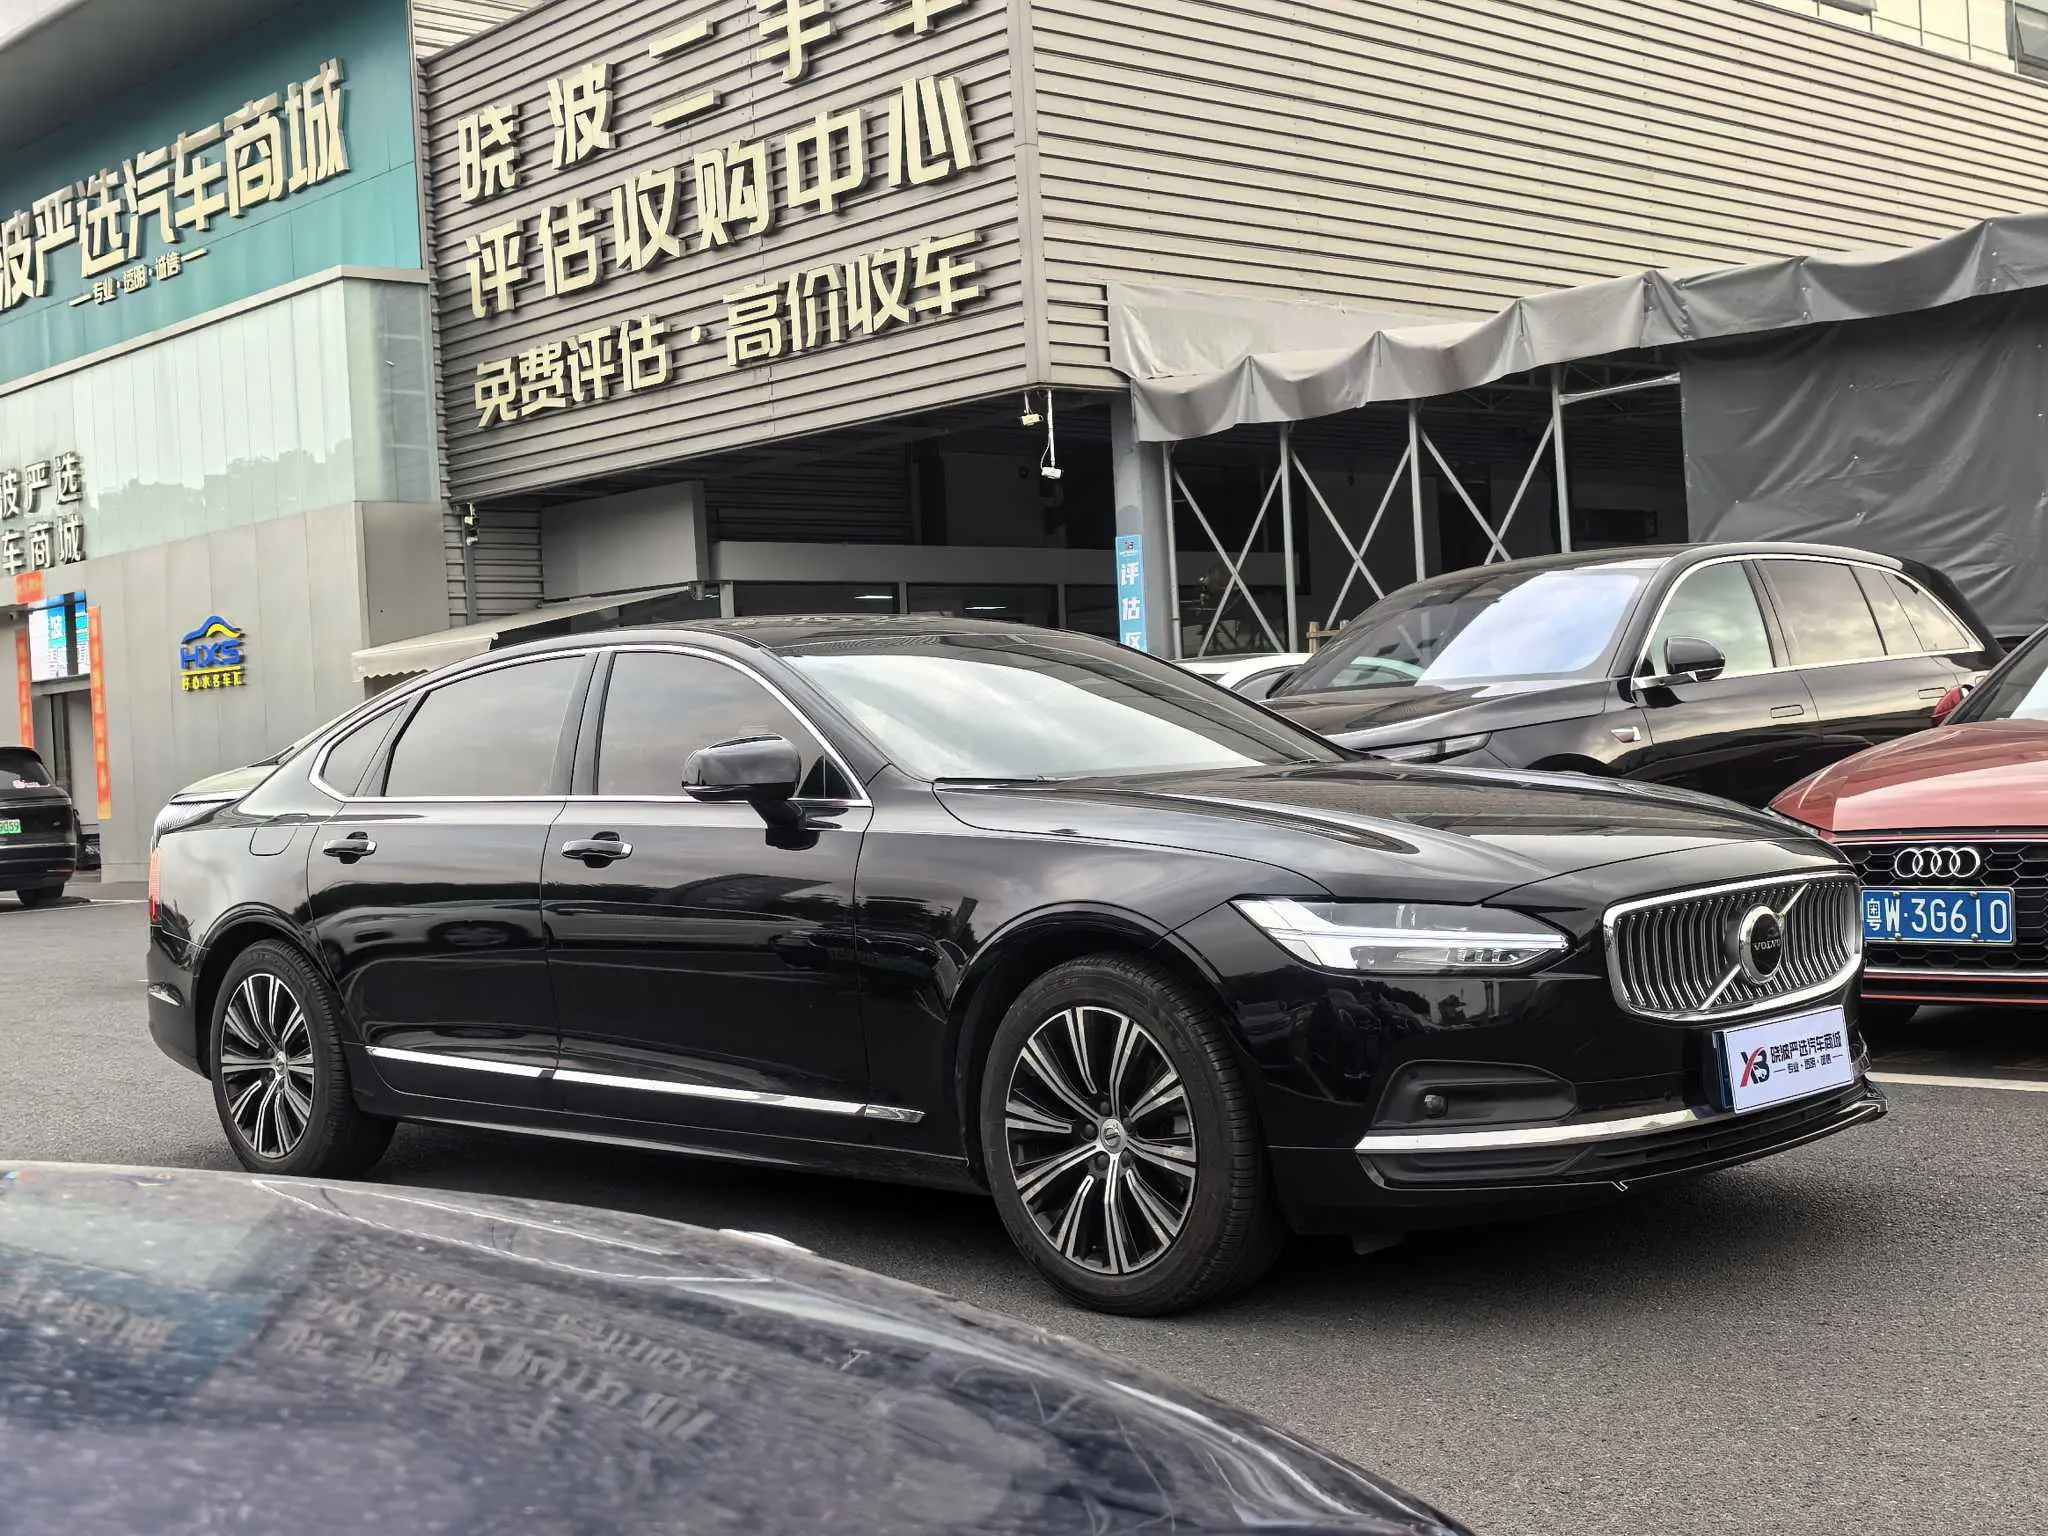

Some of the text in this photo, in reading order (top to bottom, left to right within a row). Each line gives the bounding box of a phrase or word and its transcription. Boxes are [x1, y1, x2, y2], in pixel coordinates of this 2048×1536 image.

[466, 75, 978, 318] 评估收购中心
[2, 514, 84, 575] 车商城
[180, 640, 242, 670] HXS
